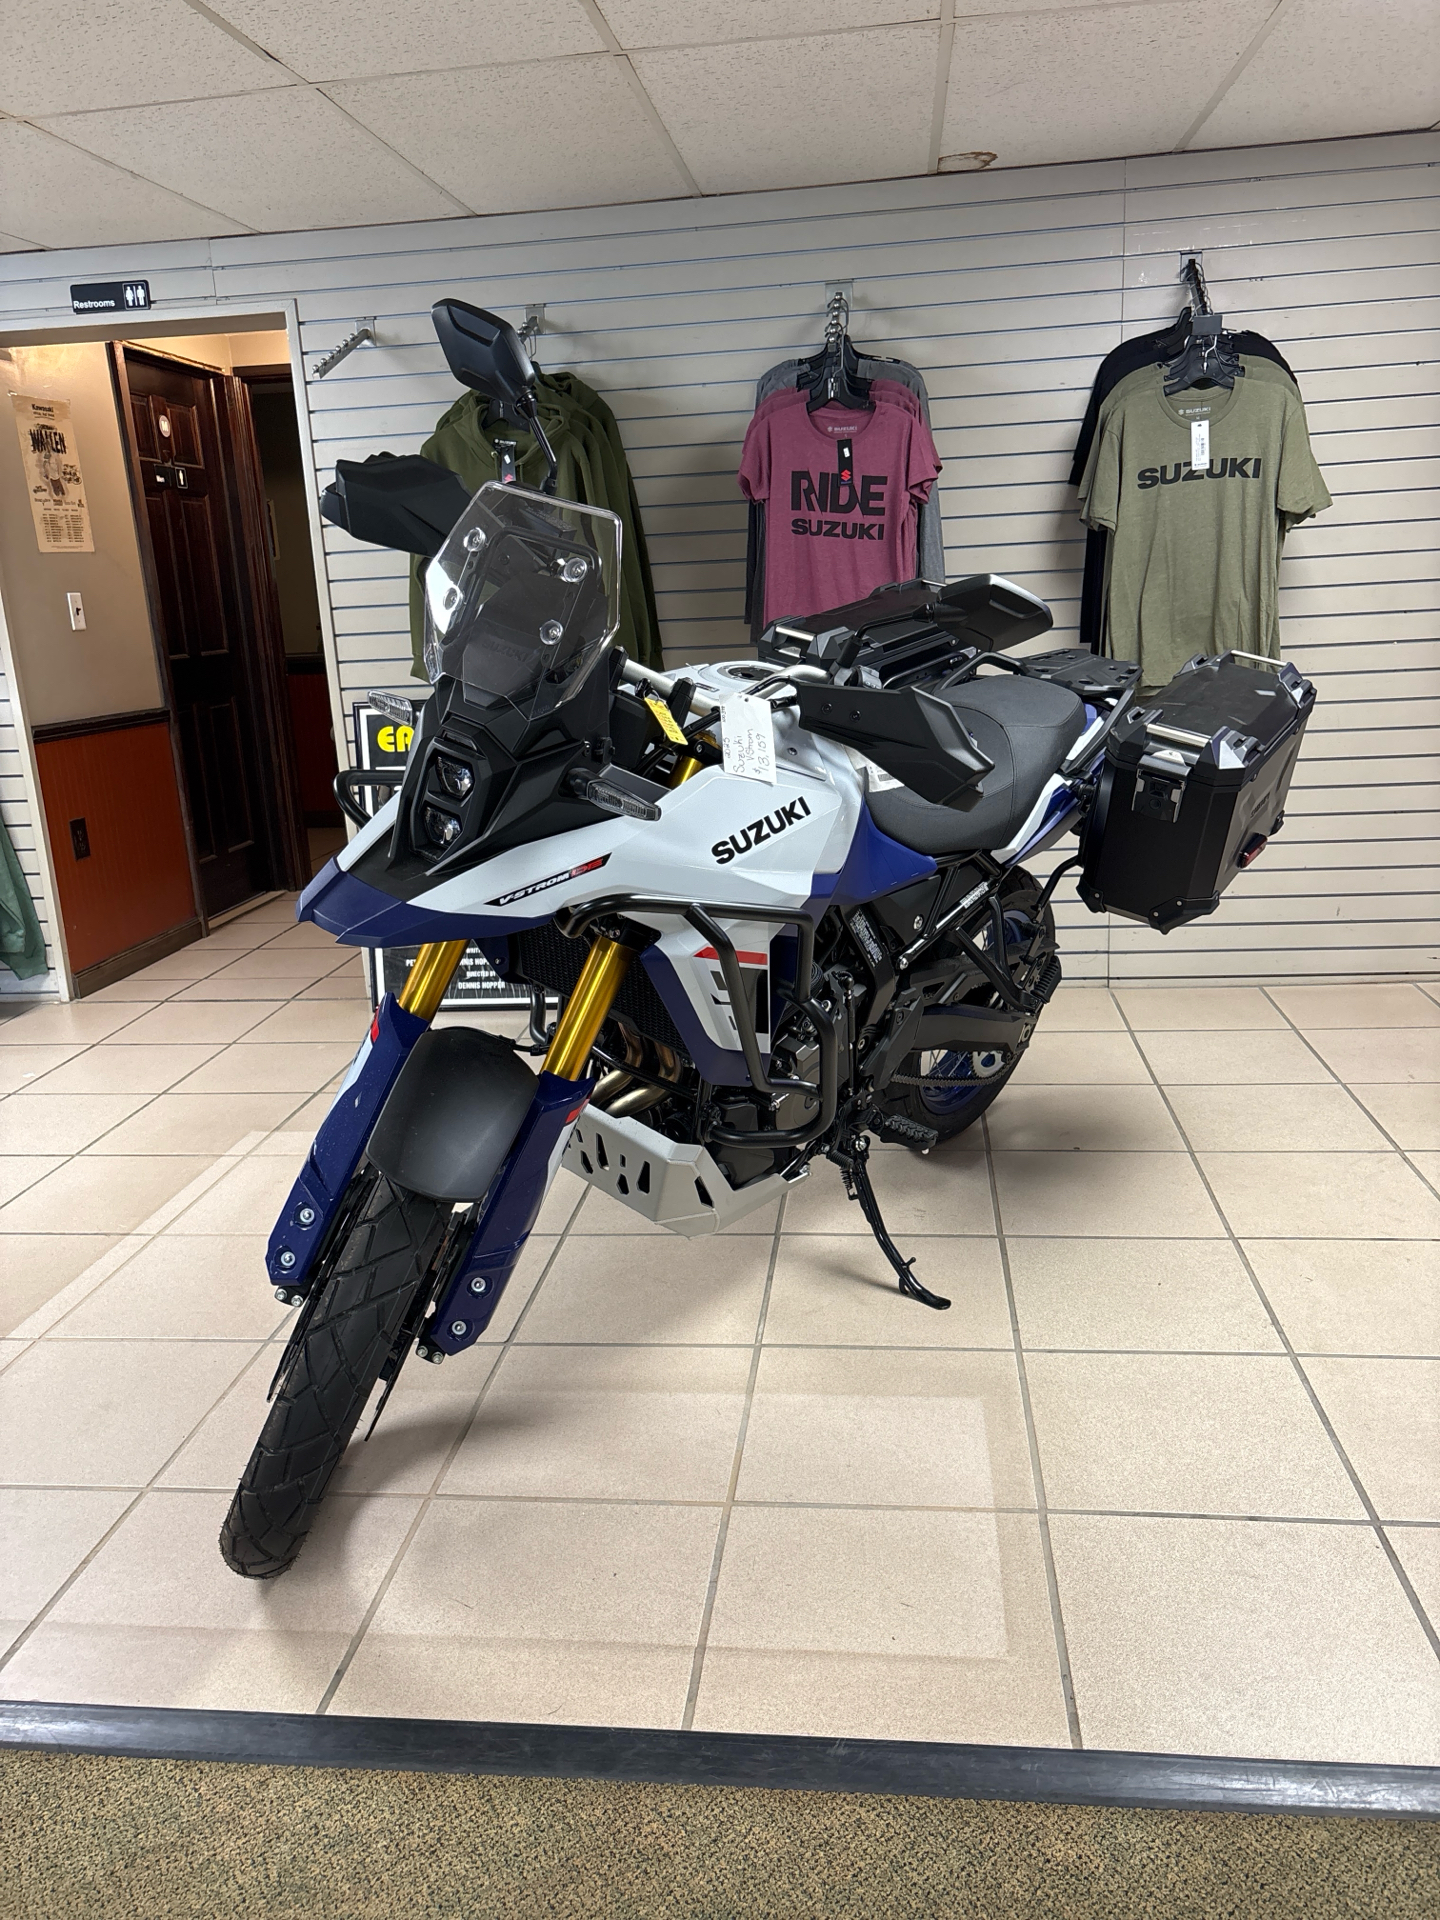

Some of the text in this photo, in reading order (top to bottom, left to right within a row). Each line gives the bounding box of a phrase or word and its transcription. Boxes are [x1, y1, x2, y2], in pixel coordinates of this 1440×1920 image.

[73, 300, 115, 309] Restrooms
[1185, 406, 1211, 414] SUZUKI
[1137, 457, 1262, 490] SUZUKI
[791, 468, 888, 518] RIDE
[791, 518, 885, 540] SUZUKI
[377, 725, 415, 752] EA
[733, 735, 746, 773] Suzuki
[711, 796, 812, 865] SUZUKI
[458, 981, 506, 990] DENNIS HOPPER
